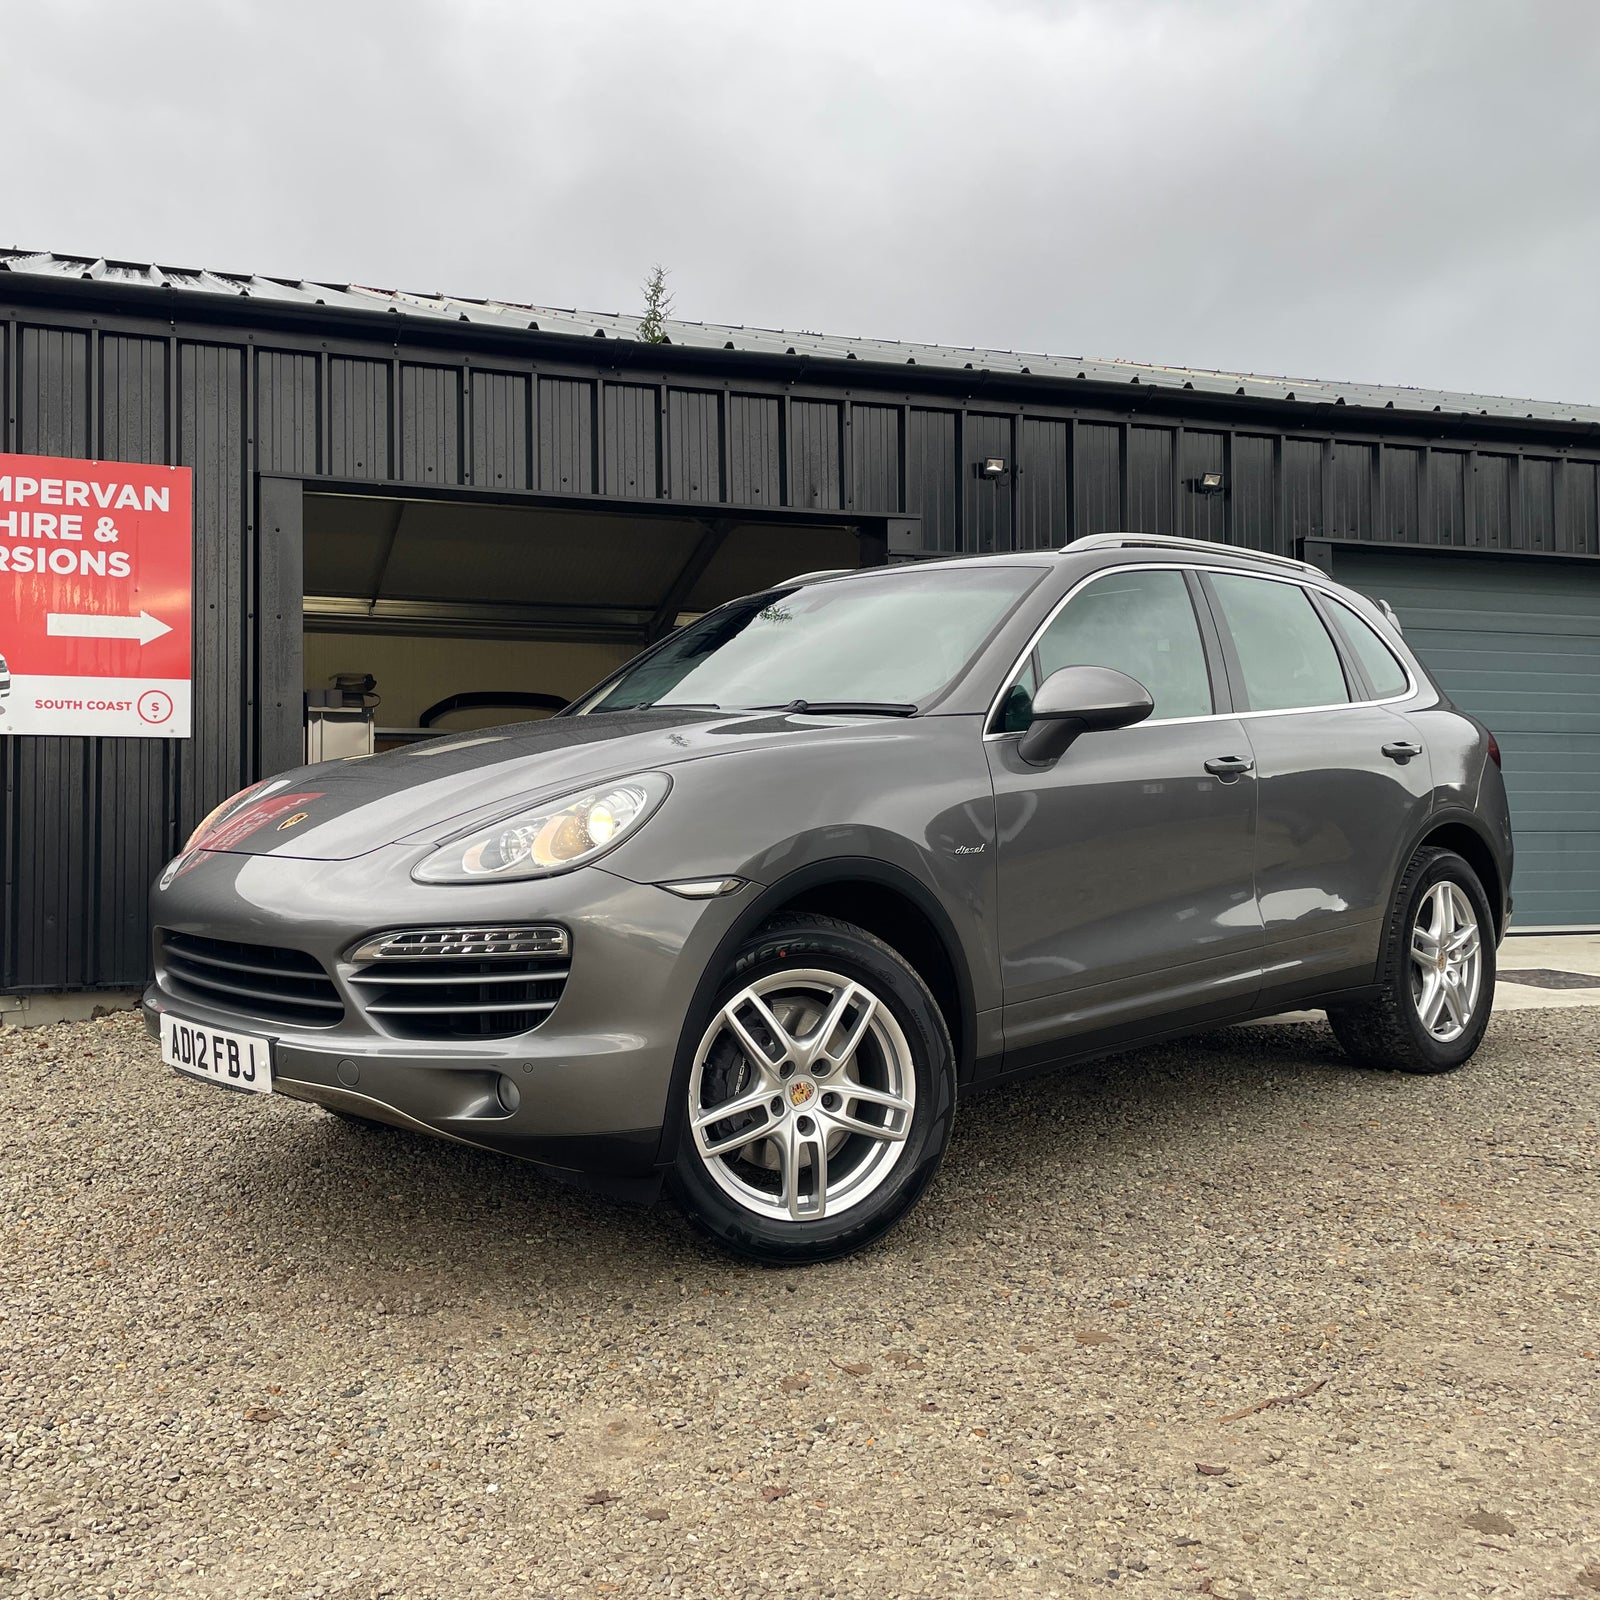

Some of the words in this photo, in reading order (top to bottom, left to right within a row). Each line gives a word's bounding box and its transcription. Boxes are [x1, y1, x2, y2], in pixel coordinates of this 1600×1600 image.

[0, 511, 83, 541] HIRE
[93, 516, 119, 543] &
[34, 699, 83, 710] SOUTH
[86, 700, 132, 711] COAST
[151, 702, 160, 712] S
[172, 1023, 208, 1070] AD12
[212, 1035, 256, 1082] FBJ
